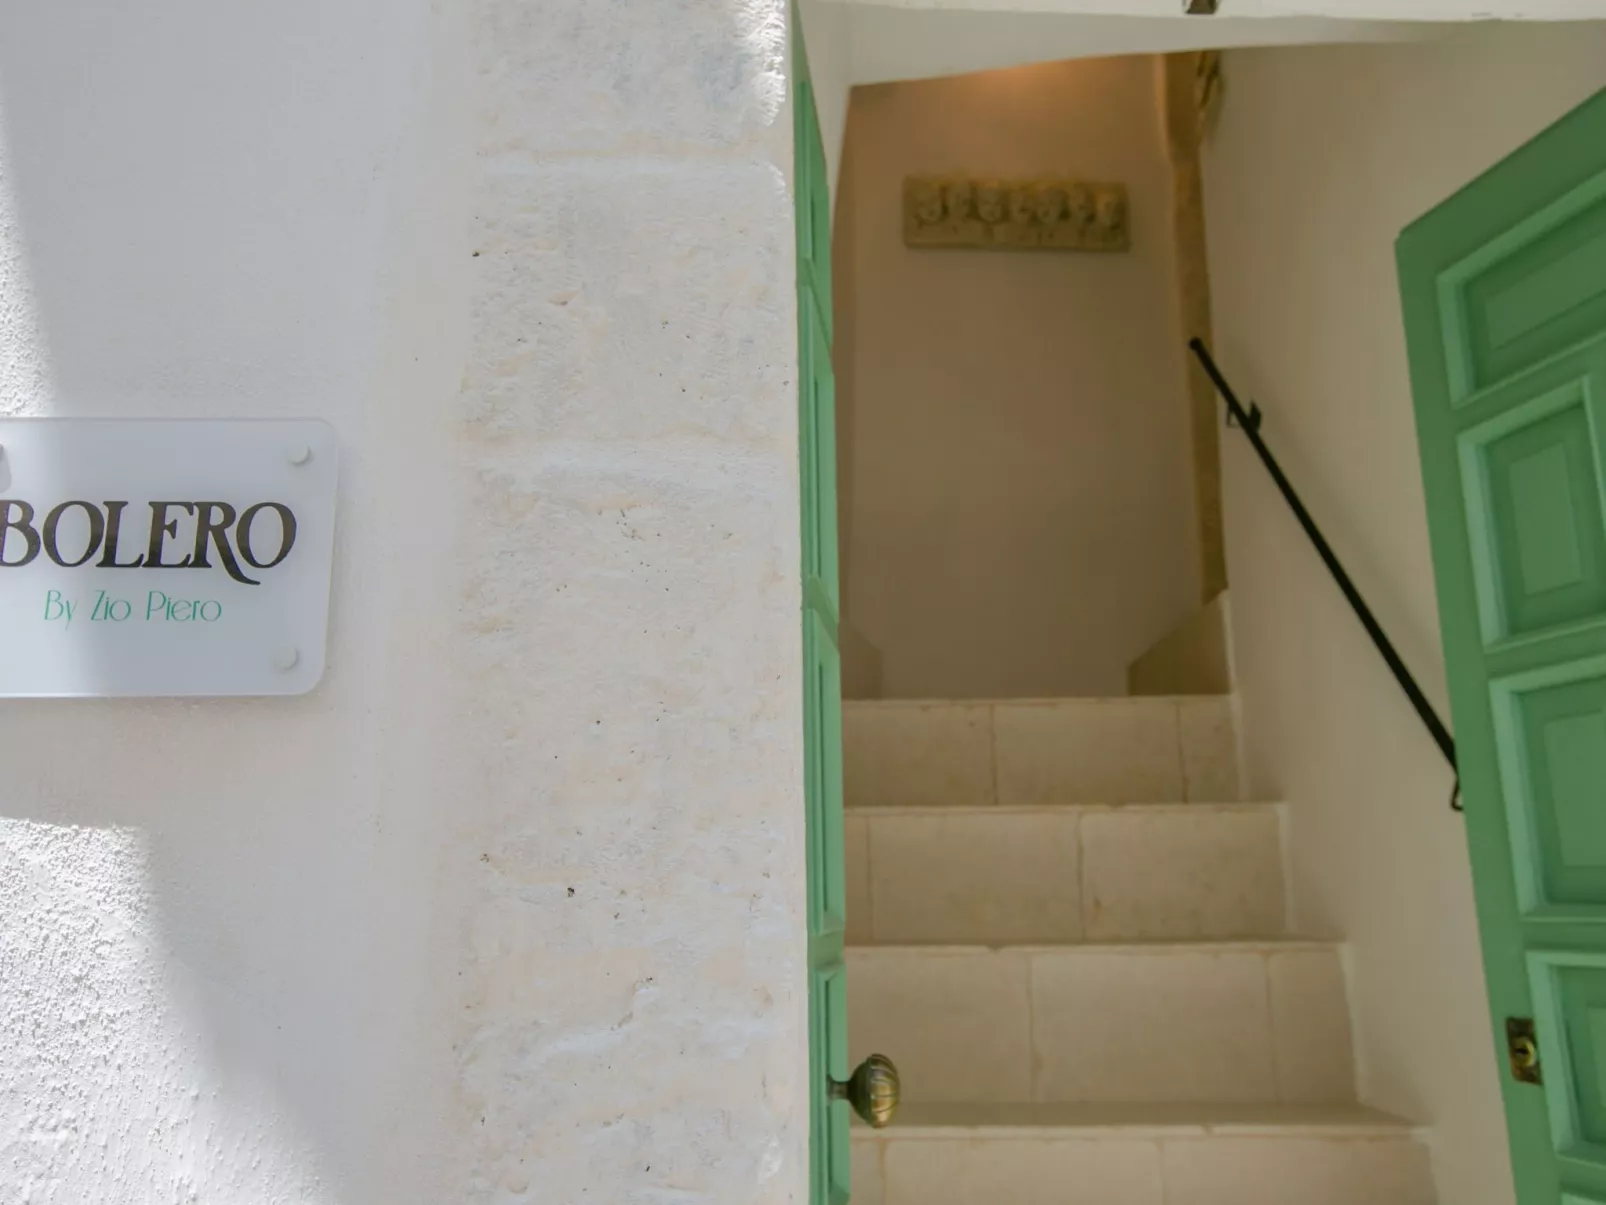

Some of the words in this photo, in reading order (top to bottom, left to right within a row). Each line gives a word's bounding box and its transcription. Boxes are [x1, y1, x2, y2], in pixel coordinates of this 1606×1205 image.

[0, 499, 297, 585] BOLERO
[44, 589, 78, 630] By
[90, 589, 132, 622] Zio
[146, 590, 222, 622] Piero
